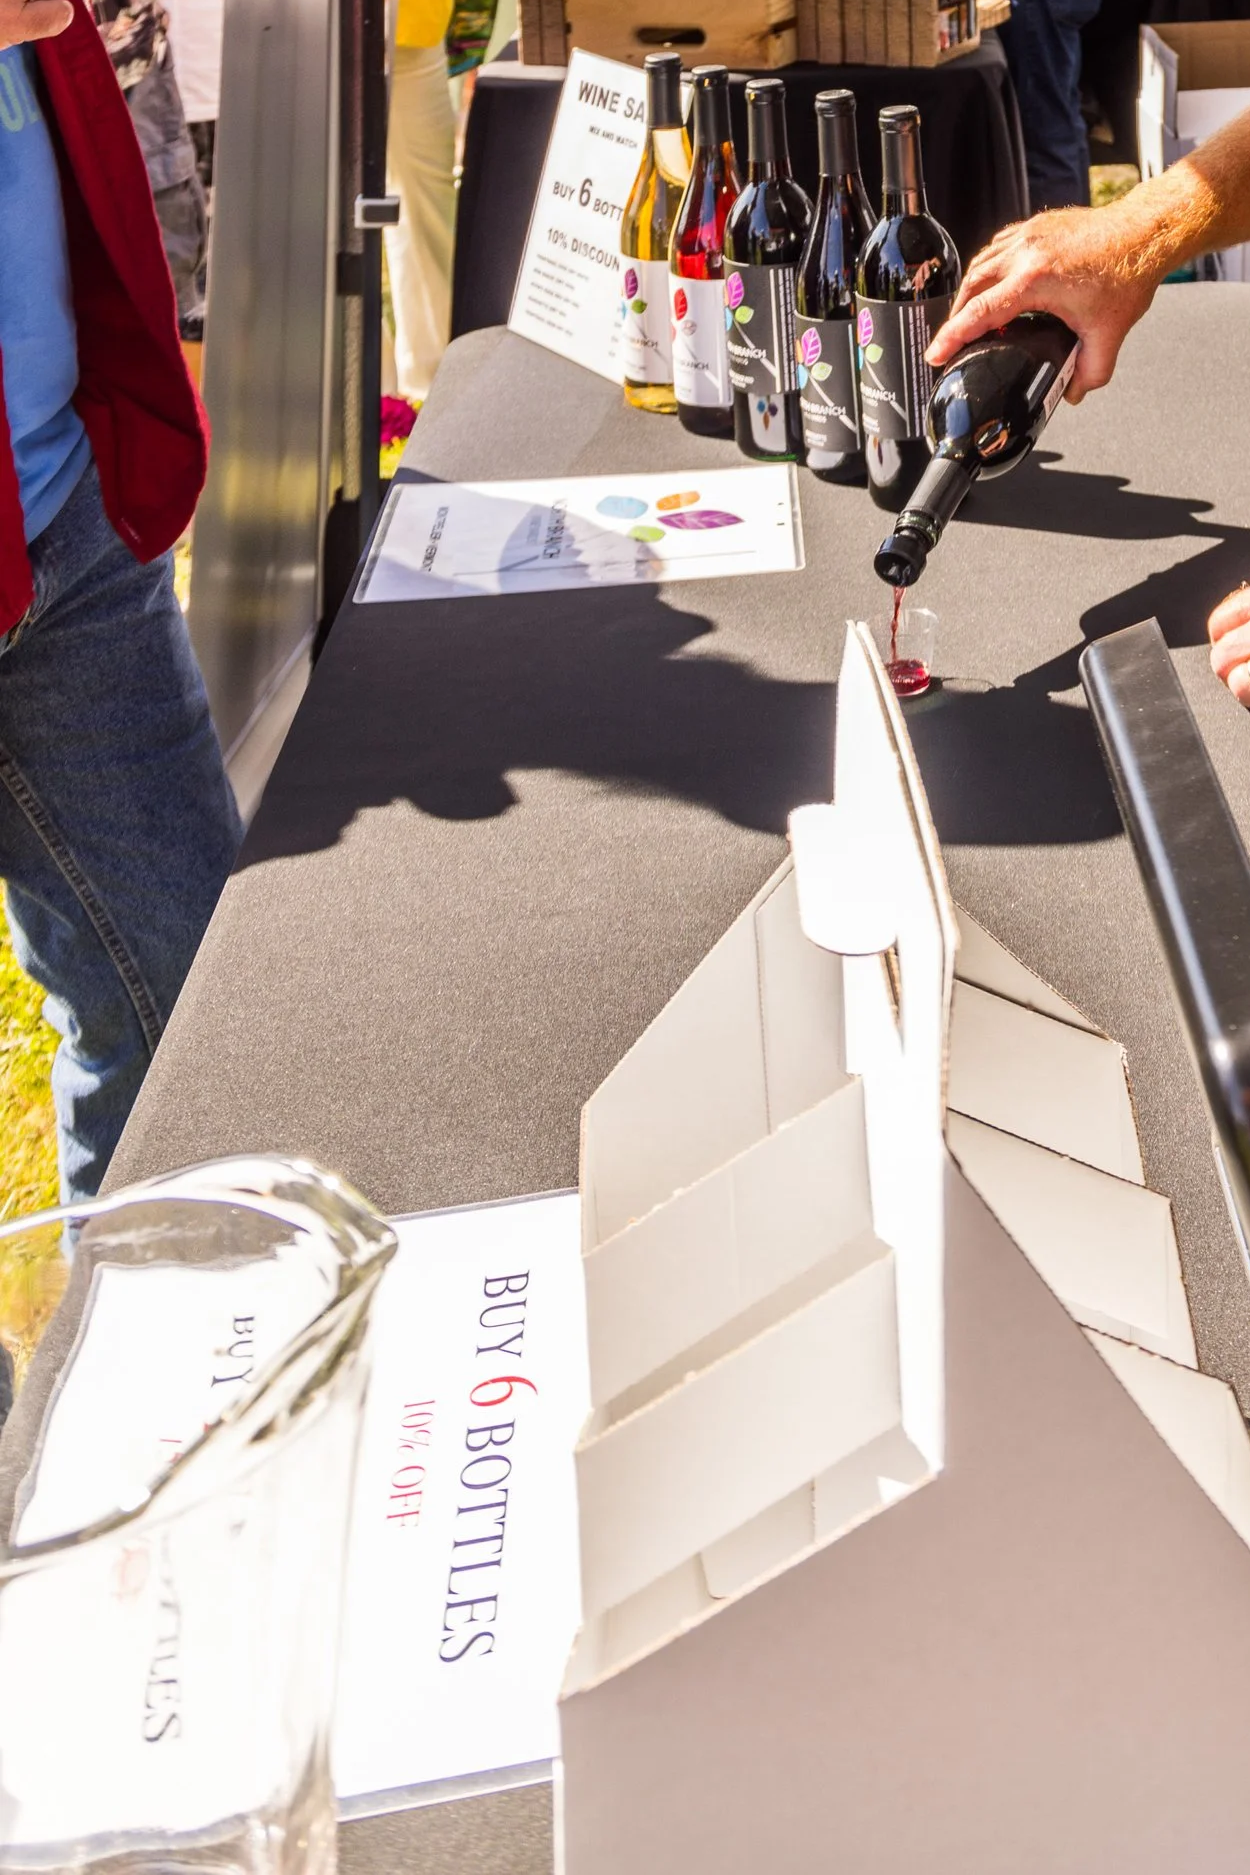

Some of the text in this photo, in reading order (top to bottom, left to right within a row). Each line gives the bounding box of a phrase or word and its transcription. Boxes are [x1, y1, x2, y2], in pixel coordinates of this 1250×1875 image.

[577, 79, 646, 124] WINE SA
[588, 126, 638, 150] MIX AND MATCH
[553, 177, 624, 222] BUY 6 BOTT
[547, 228, 568, 250] 10%
[571, 242, 621, 273] DISCOUN
[386, 1398, 437, 1528] 10% OFF
[438, 1269, 540, 1664] BUY 6 BOTTLES
